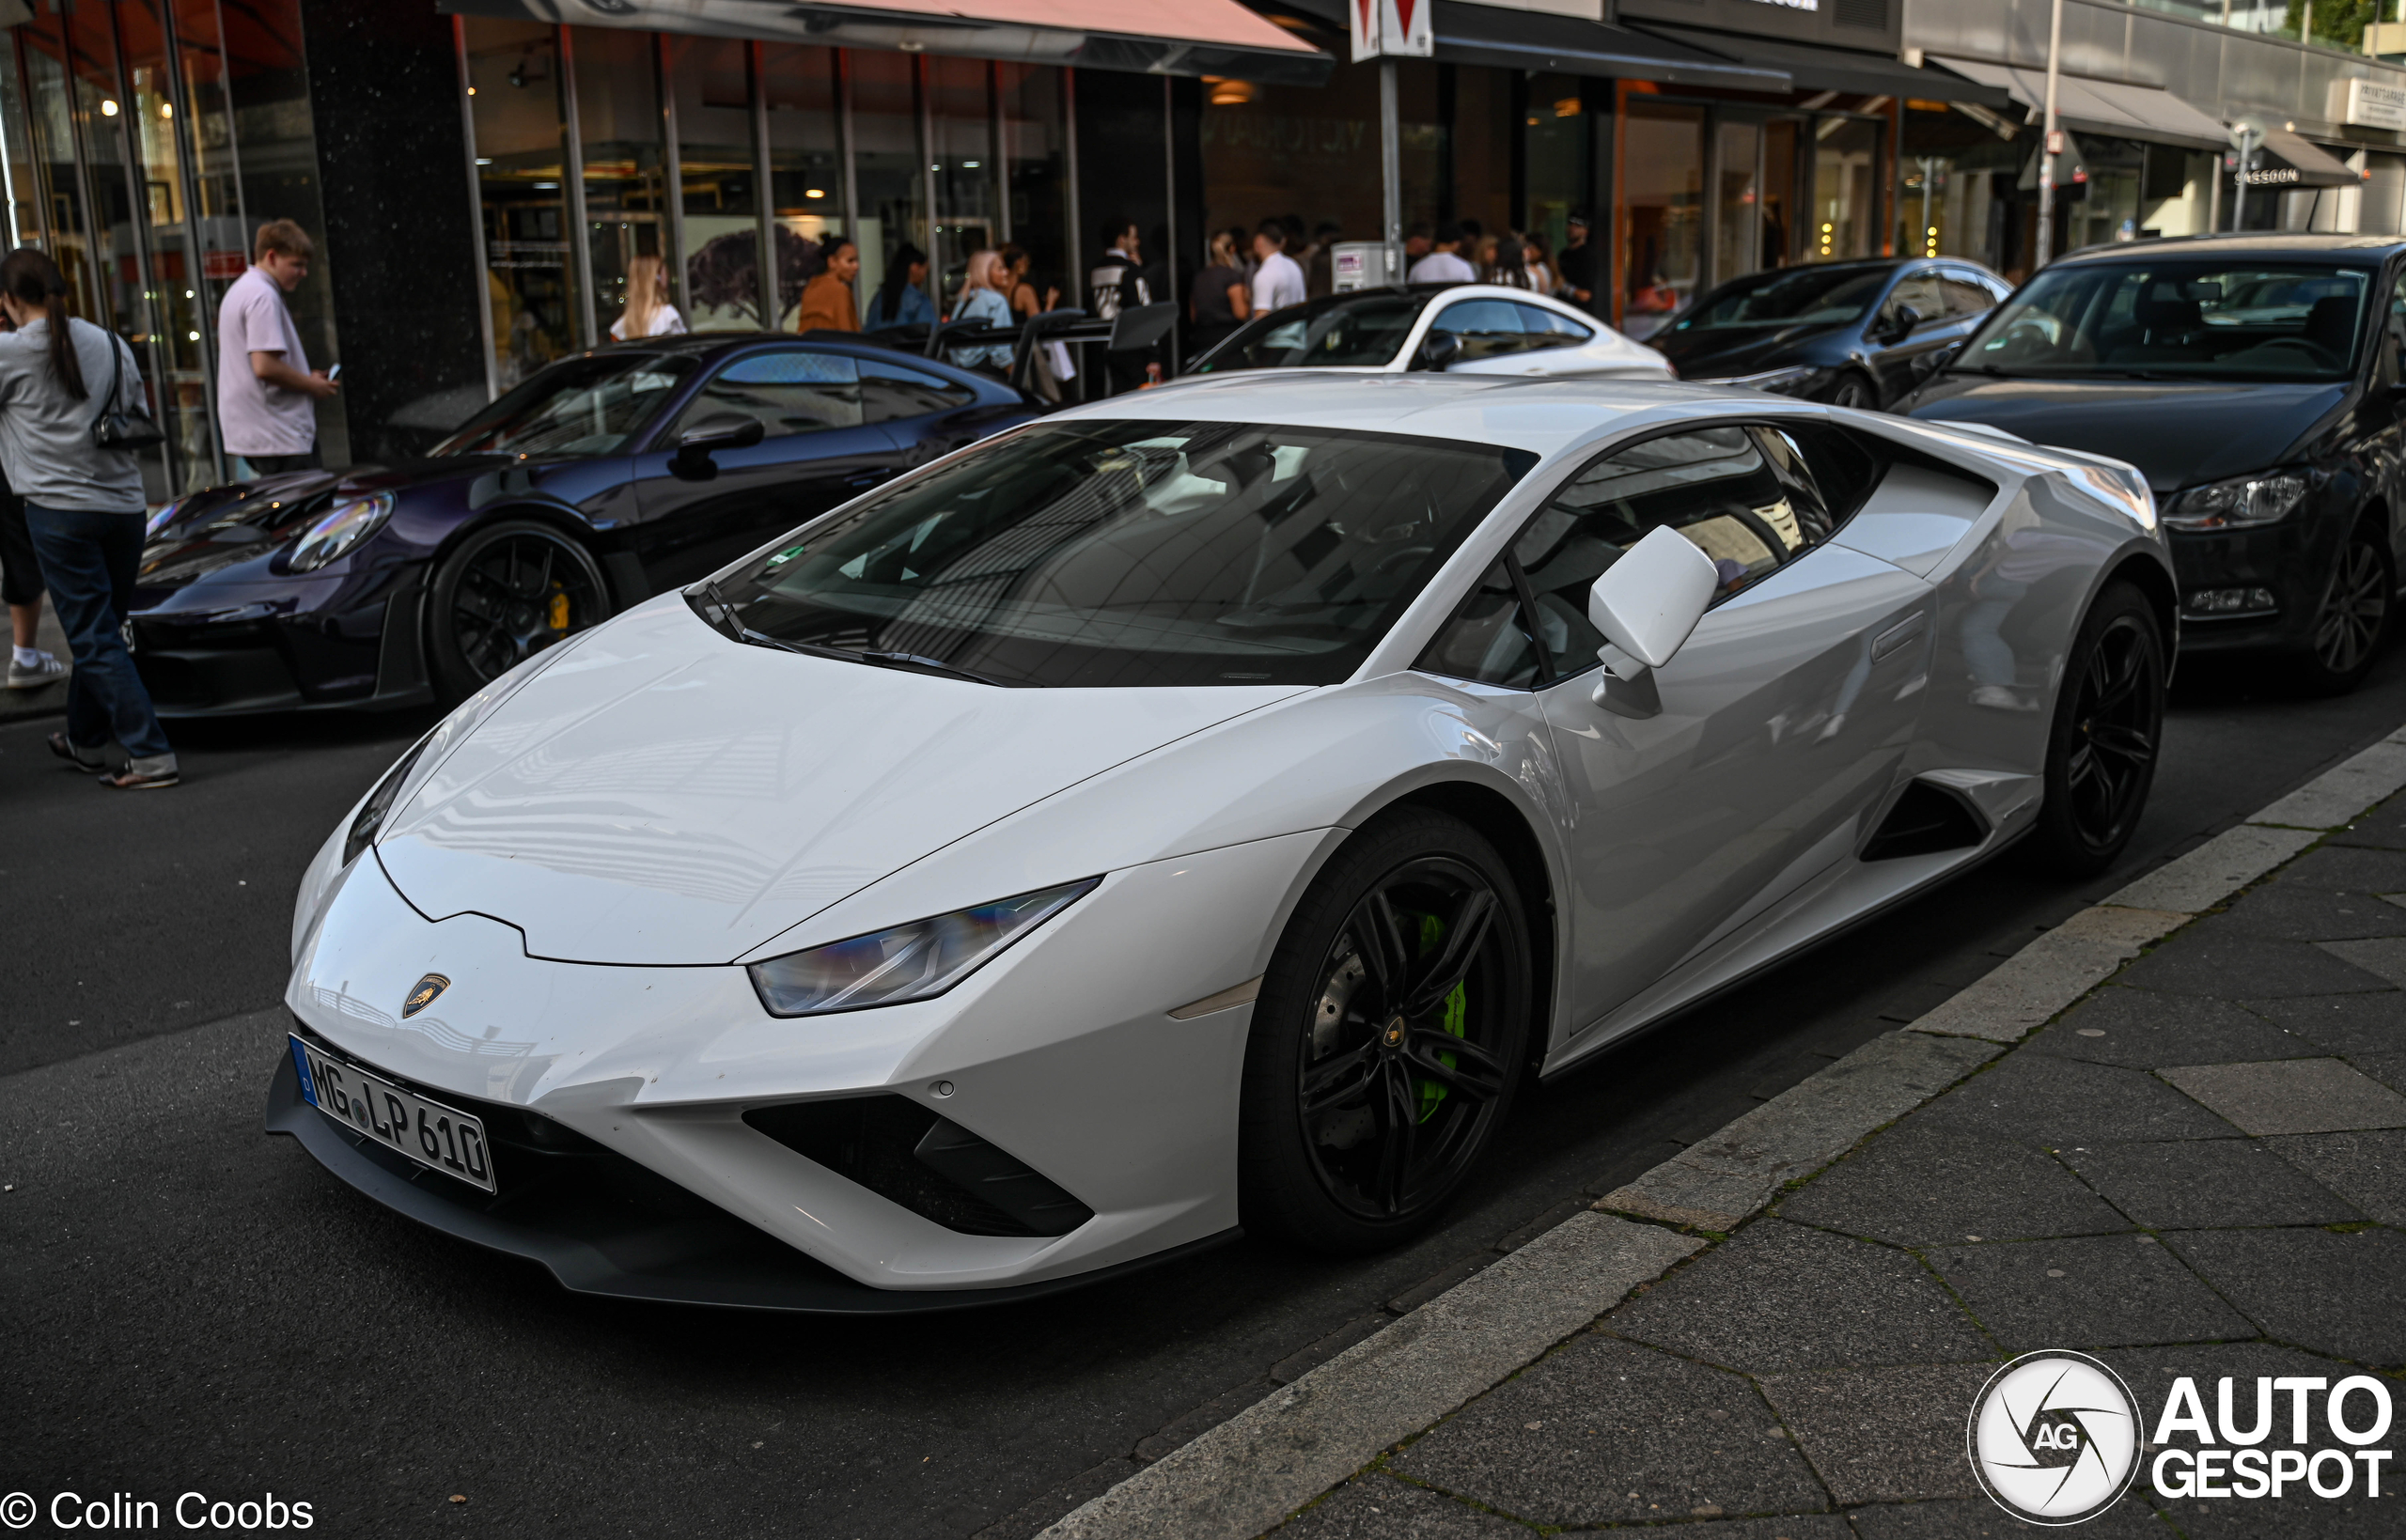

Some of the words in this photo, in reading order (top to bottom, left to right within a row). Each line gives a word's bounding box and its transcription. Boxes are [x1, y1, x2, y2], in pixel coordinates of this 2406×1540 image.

[303, 1077, 310, 1091] D
[306, 1051, 352, 1120] MG
[363, 1081, 408, 1145] LP
[418, 1107, 488, 1181] 610
